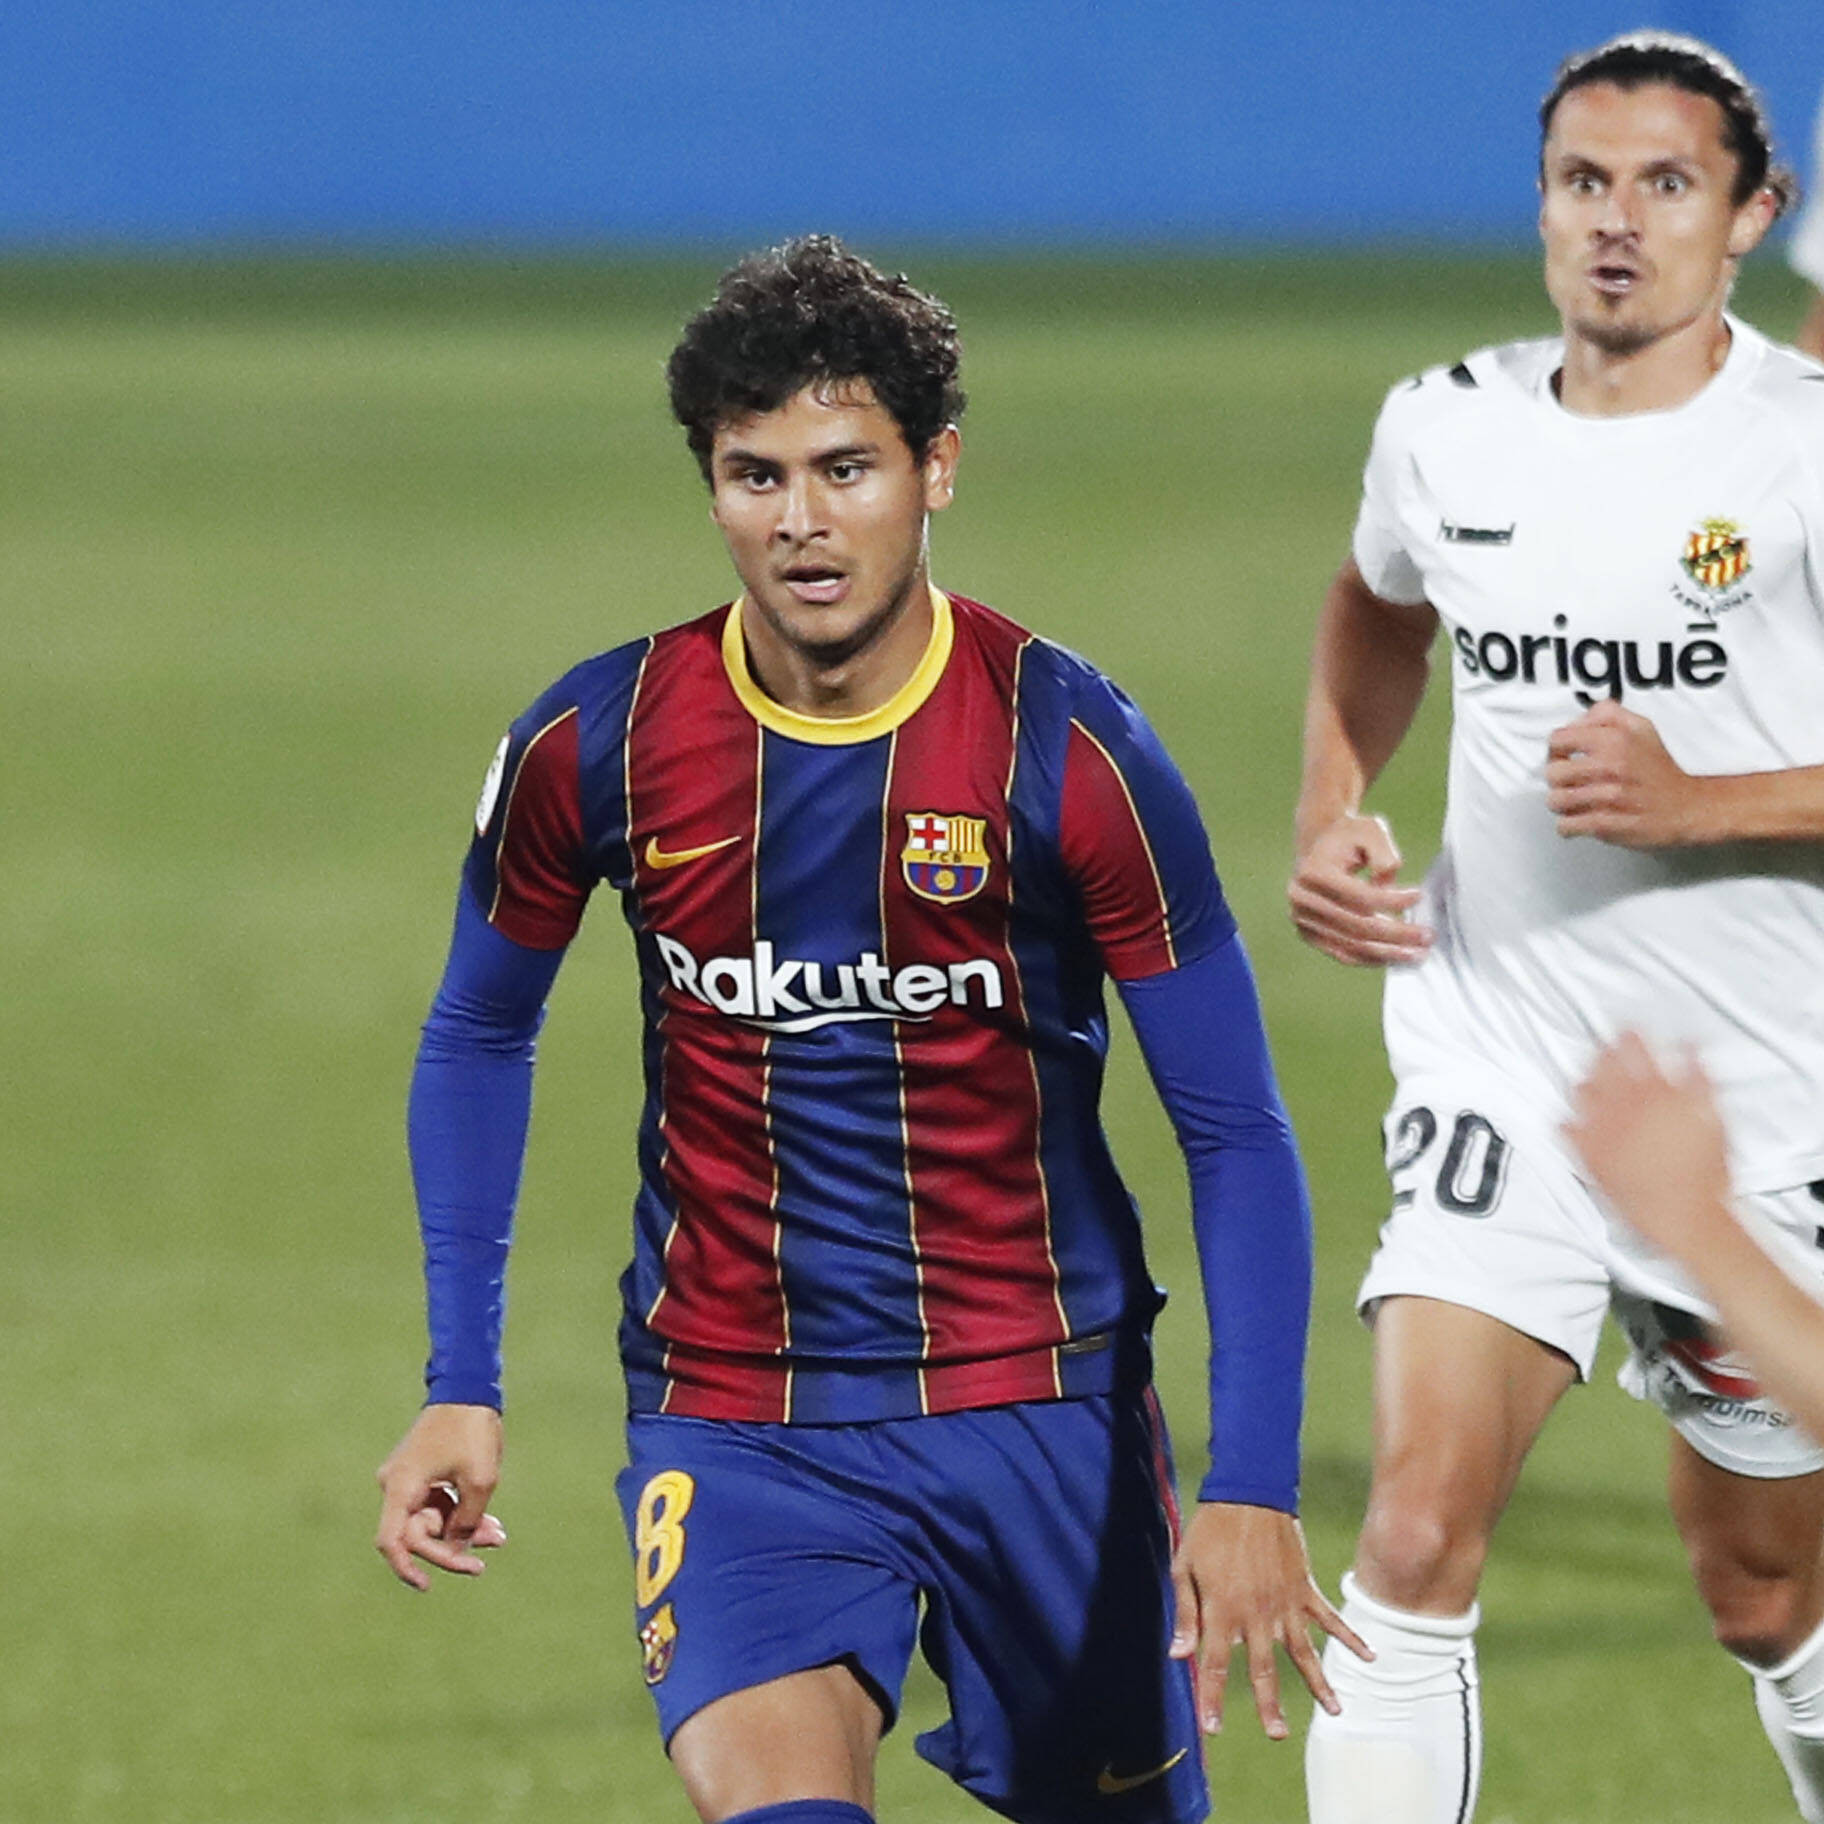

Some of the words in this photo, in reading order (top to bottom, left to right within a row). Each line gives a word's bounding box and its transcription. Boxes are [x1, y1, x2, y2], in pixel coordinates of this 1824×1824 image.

[655, 932, 1004, 1024] Rakuten
[1380, 1105, 1514, 1219] 20
[634, 1469, 746, 1609] 8
